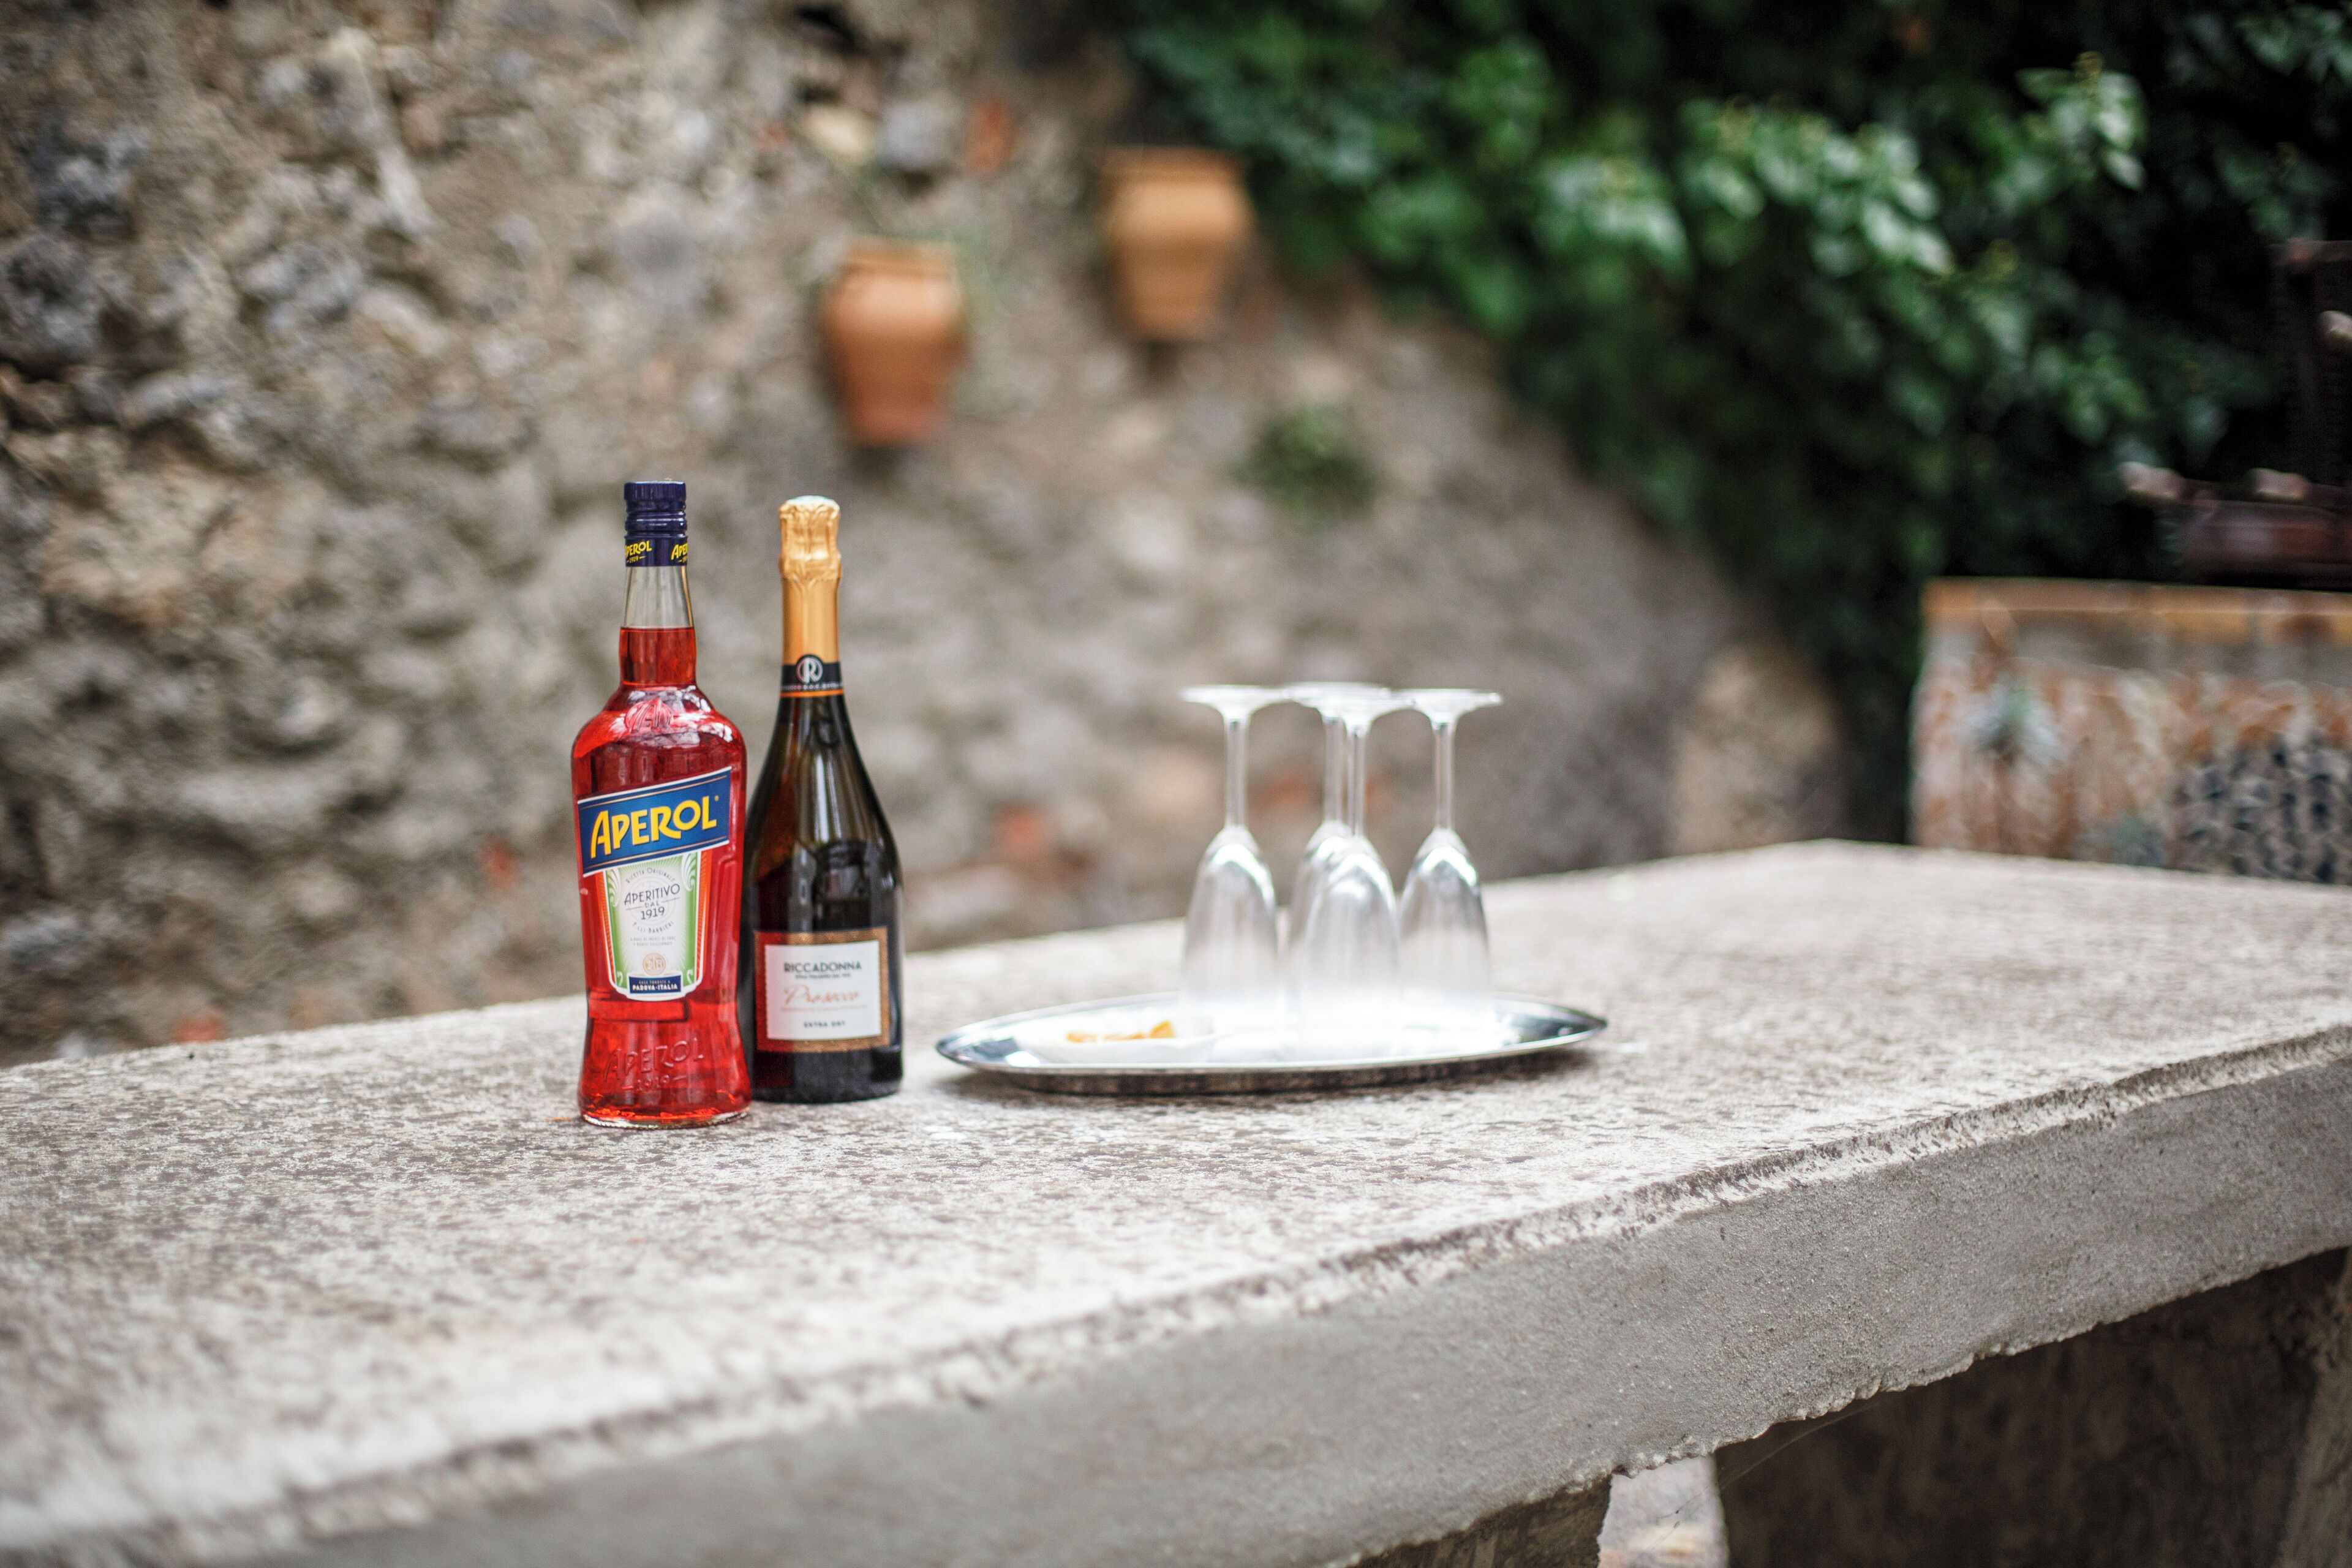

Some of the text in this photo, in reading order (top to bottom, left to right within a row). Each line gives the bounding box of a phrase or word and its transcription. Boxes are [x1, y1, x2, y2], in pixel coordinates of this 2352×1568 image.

[625, 540, 652, 559] PEROL
[590, 796, 717, 859] APEROL
[624, 883, 680, 906] APERITIVO
[640, 906, 665, 920] 1919
[783, 961, 862, 973] RICCADONNA
